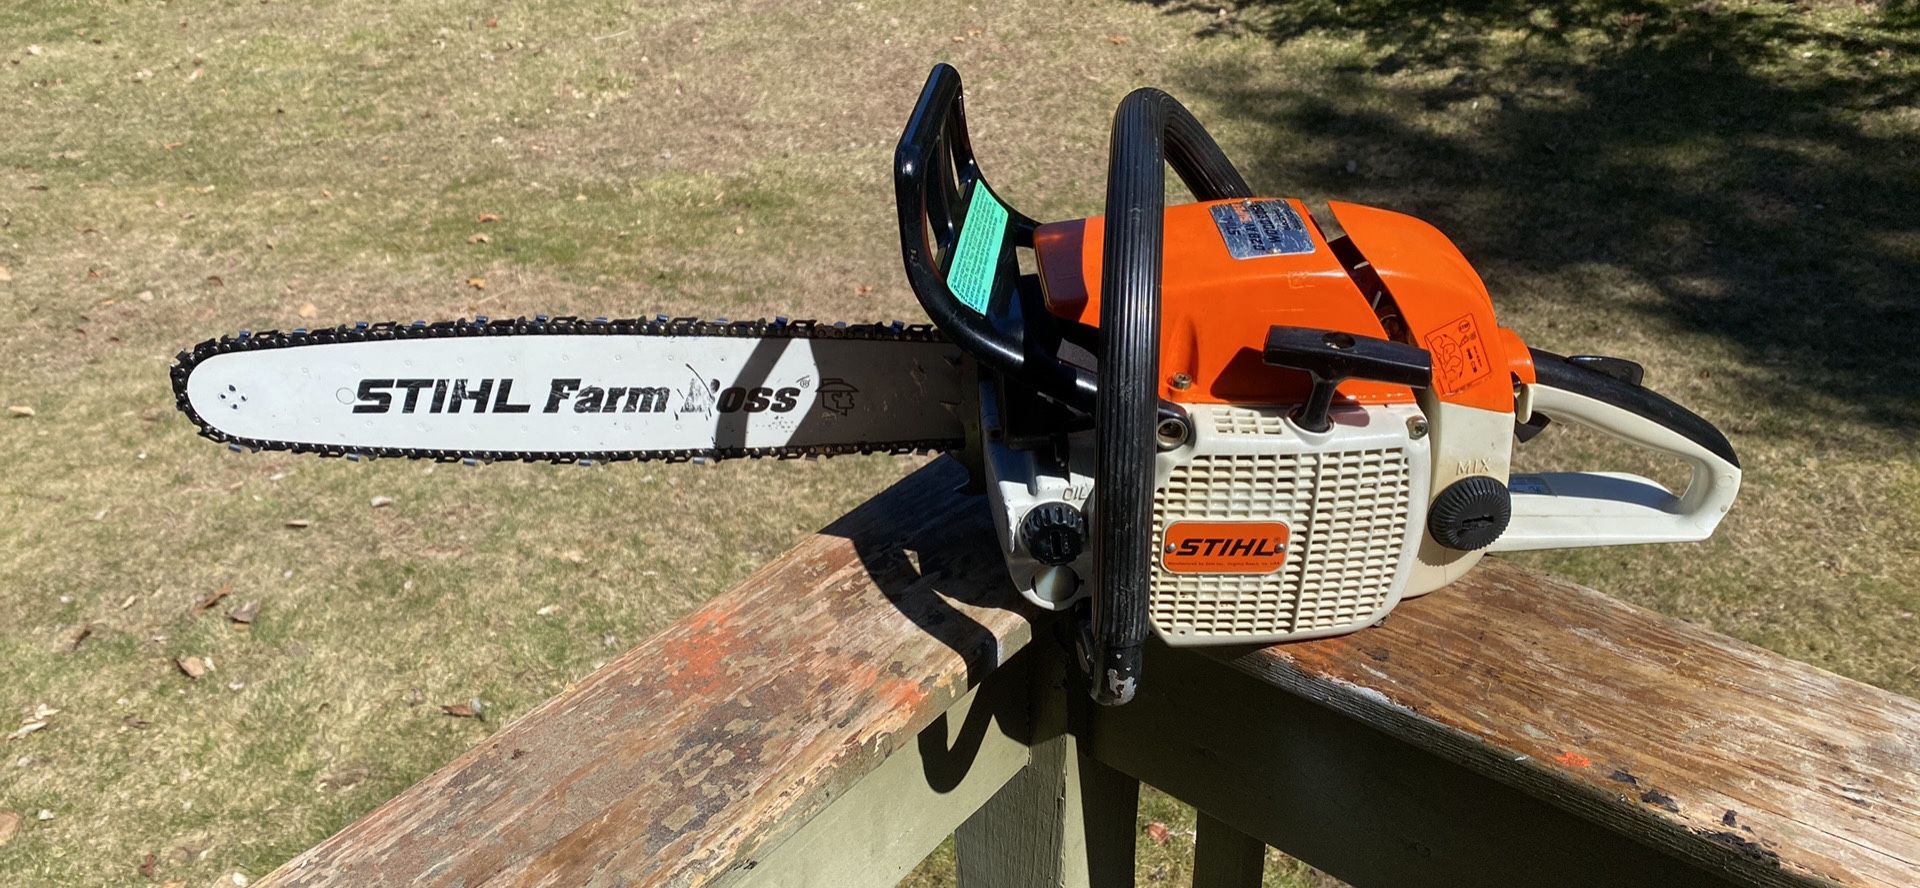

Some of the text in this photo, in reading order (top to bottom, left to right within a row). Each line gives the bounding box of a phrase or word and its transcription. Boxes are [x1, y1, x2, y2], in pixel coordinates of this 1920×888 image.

[352, 377, 531, 414] STIHL
[542, 378, 669, 414] Farm
[1456, 457, 1491, 476] MIX
[1062, 486, 1088, 501] OIL
[1176, 538, 1275, 557] STIHL
